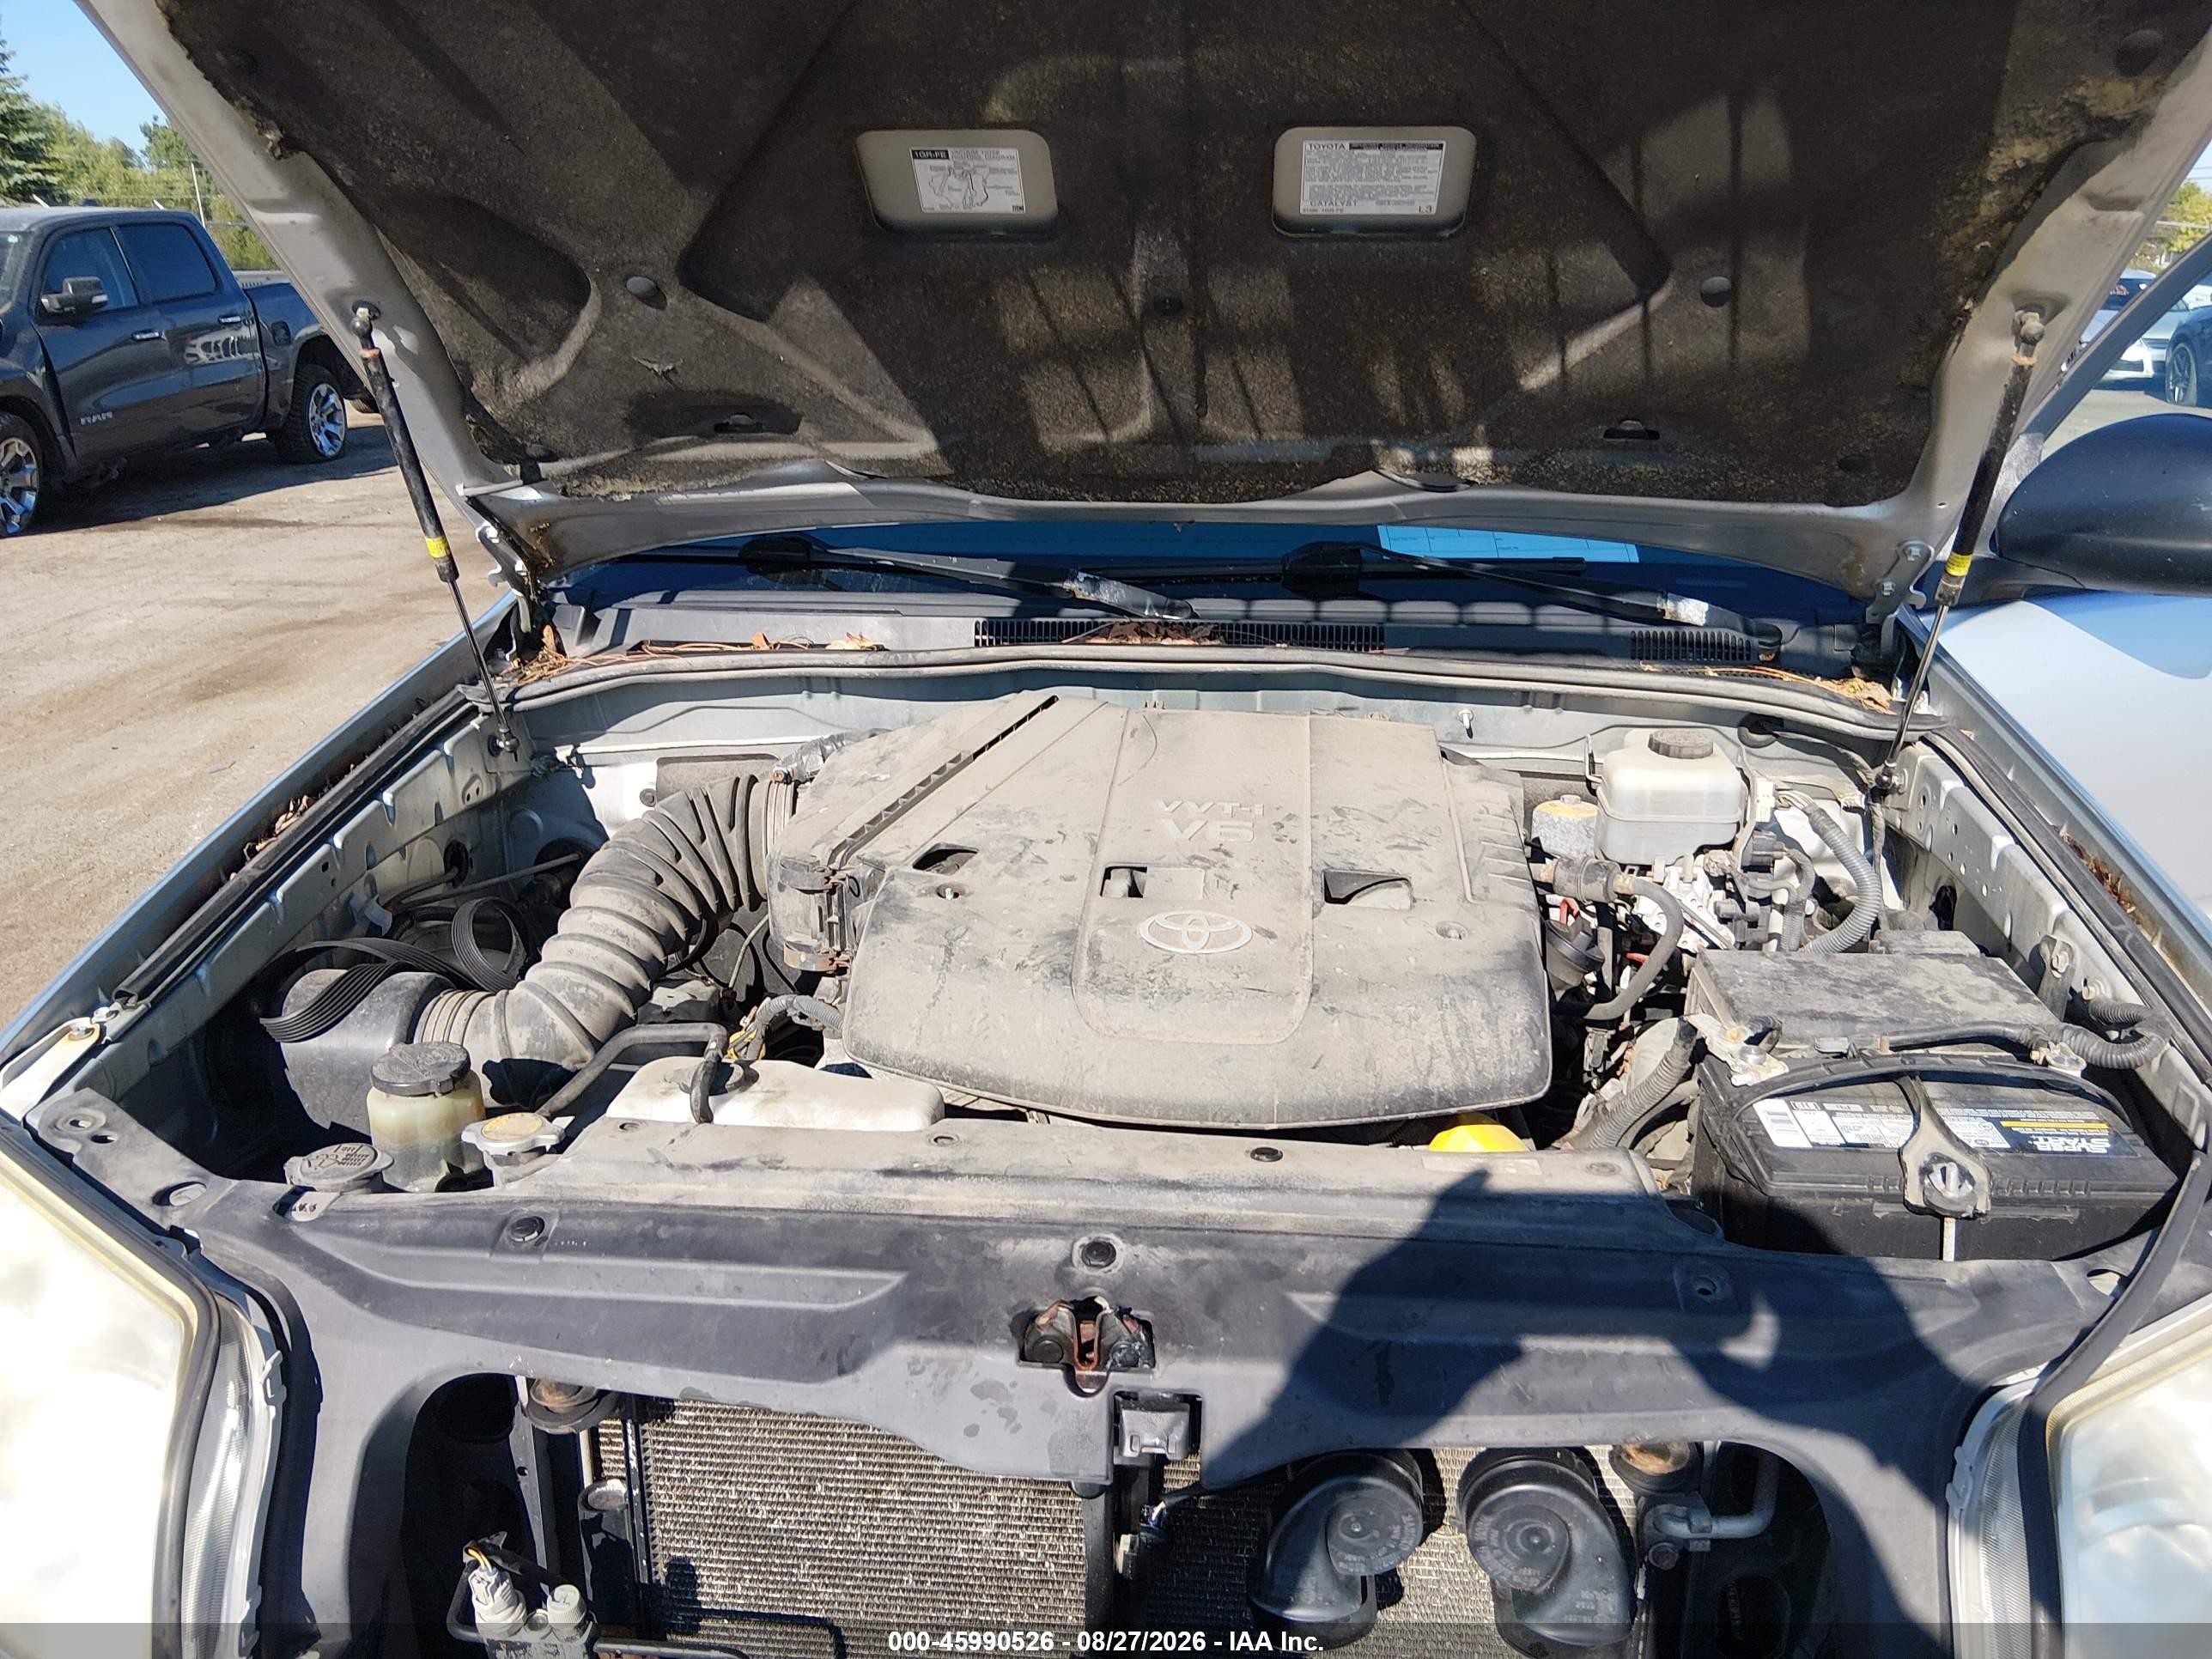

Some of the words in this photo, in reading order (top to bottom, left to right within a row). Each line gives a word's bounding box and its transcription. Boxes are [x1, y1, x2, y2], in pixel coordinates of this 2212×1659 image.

[1309, 143, 1346, 151] TOYOTA
[81, 412, 112, 425] RAM
[1161, 818, 1255, 842] V6
[2031, 1136, 2110, 1148] START
[2033, 1141, 2108, 1153] SUPER
